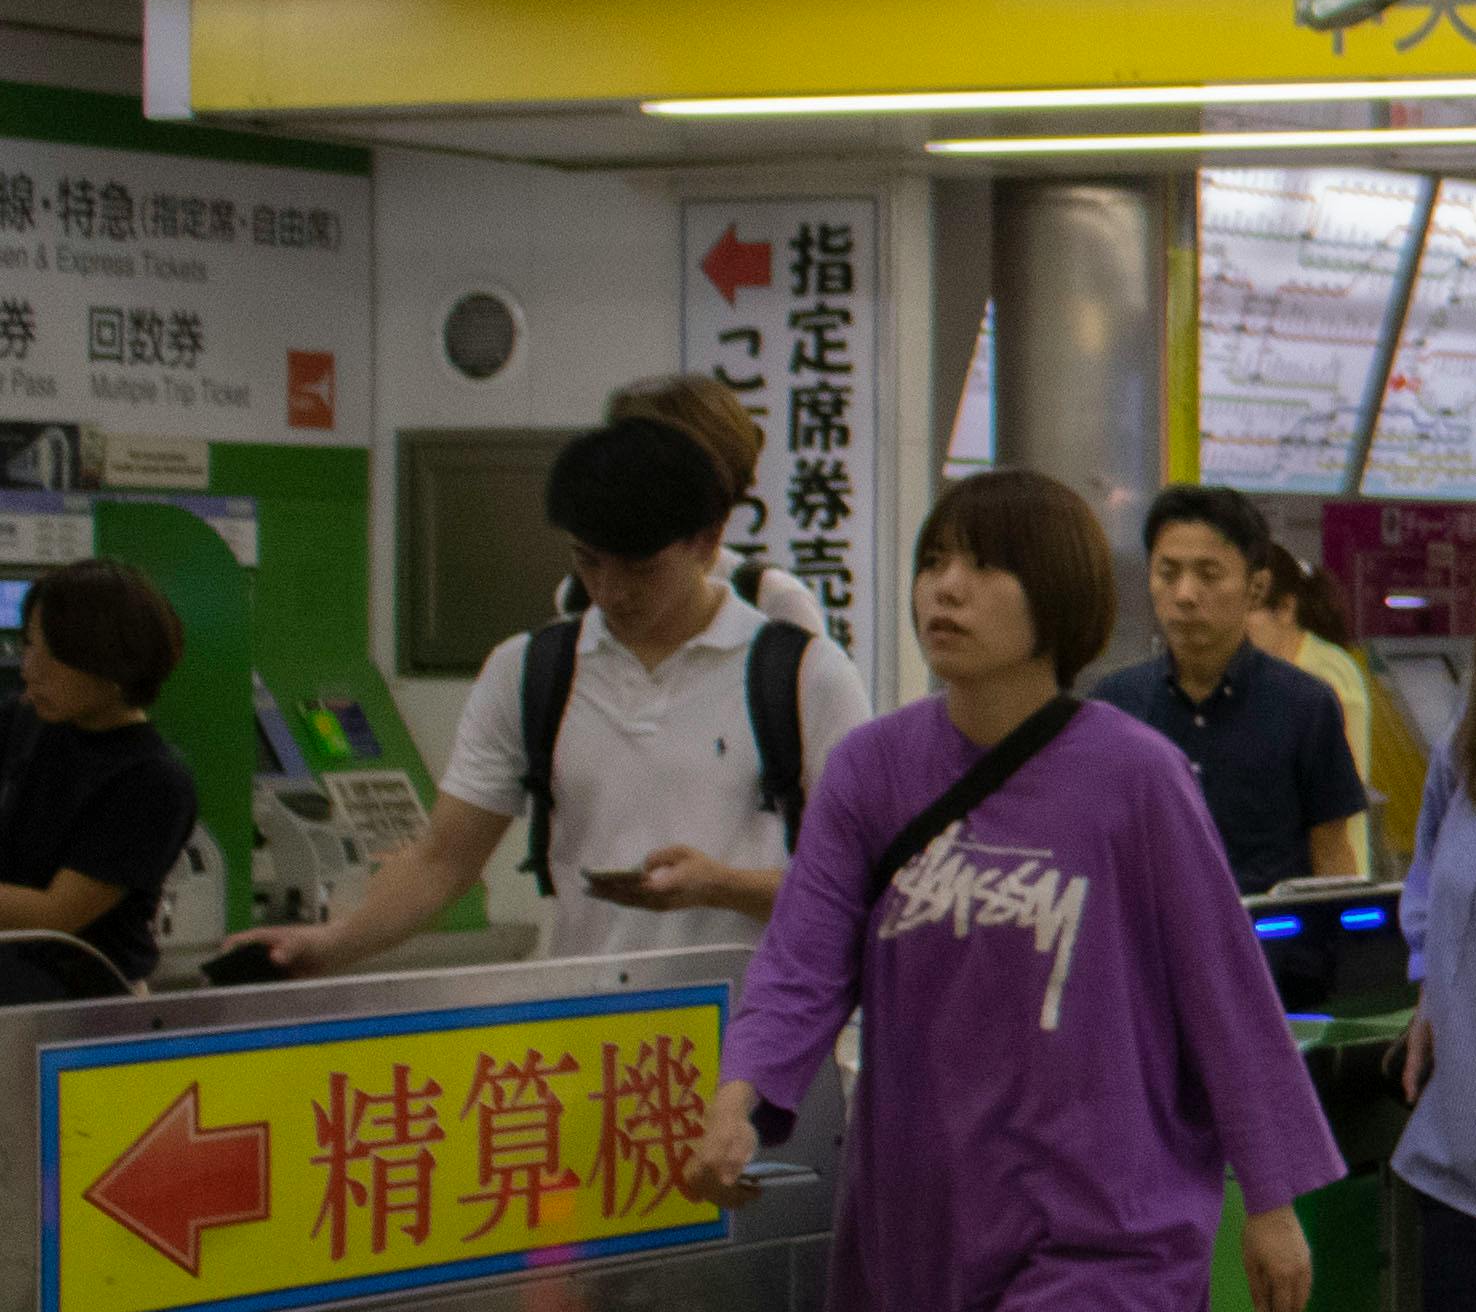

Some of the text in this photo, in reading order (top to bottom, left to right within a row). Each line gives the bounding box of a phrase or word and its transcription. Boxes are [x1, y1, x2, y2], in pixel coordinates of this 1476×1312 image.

[89, 305, 204, 368] 回数券
[788, 222, 855, 657] 指定席券売
[309, 1035, 708, 1262] 精算機
